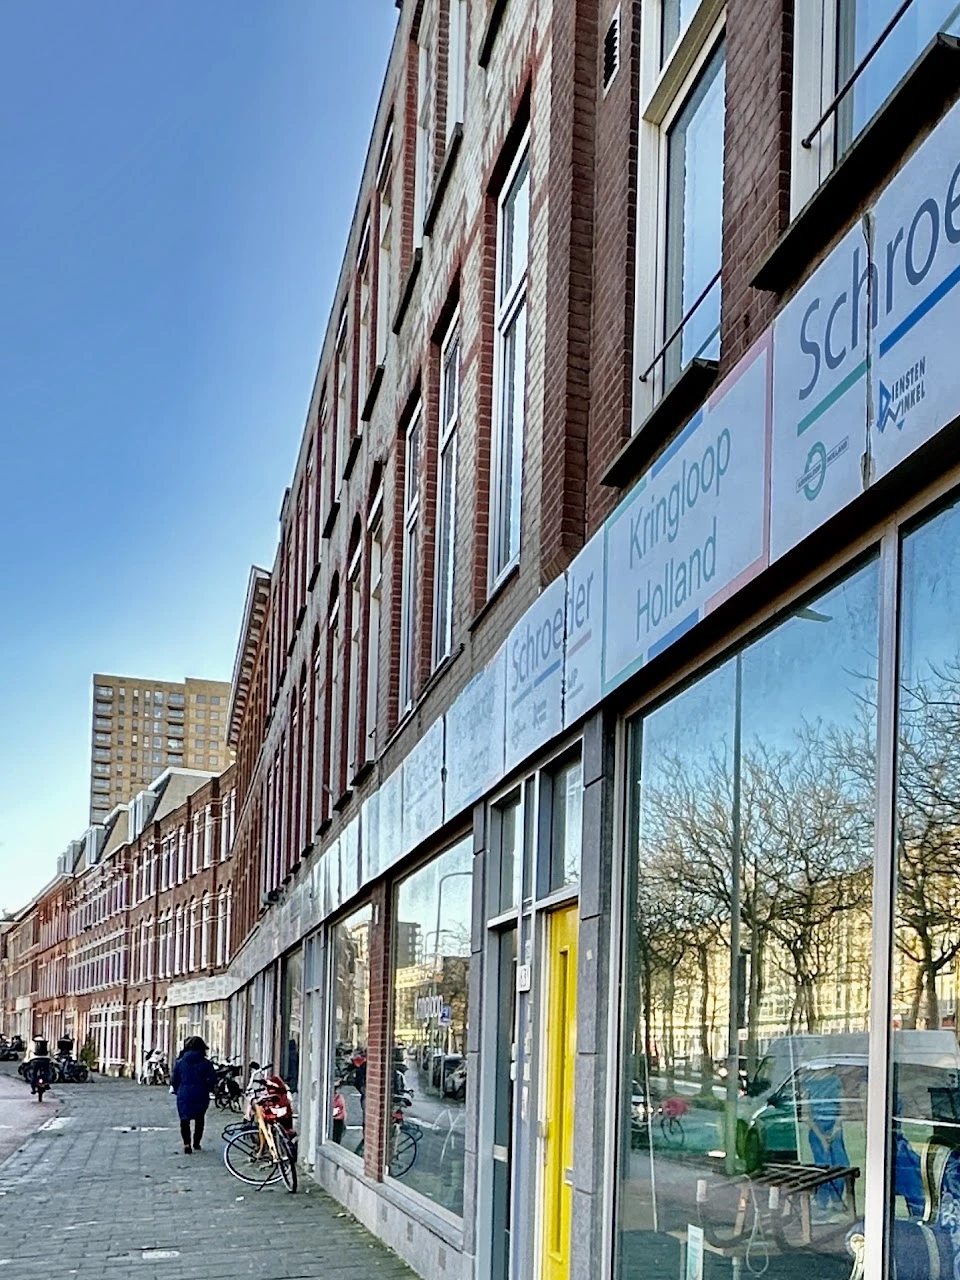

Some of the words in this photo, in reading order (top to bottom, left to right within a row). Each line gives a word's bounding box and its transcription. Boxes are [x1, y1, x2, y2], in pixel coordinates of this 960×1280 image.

[629, 428, 731, 569] Kringloop
[511, 571, 594, 692] Schroeder
[636, 516, 717, 642] Holland
